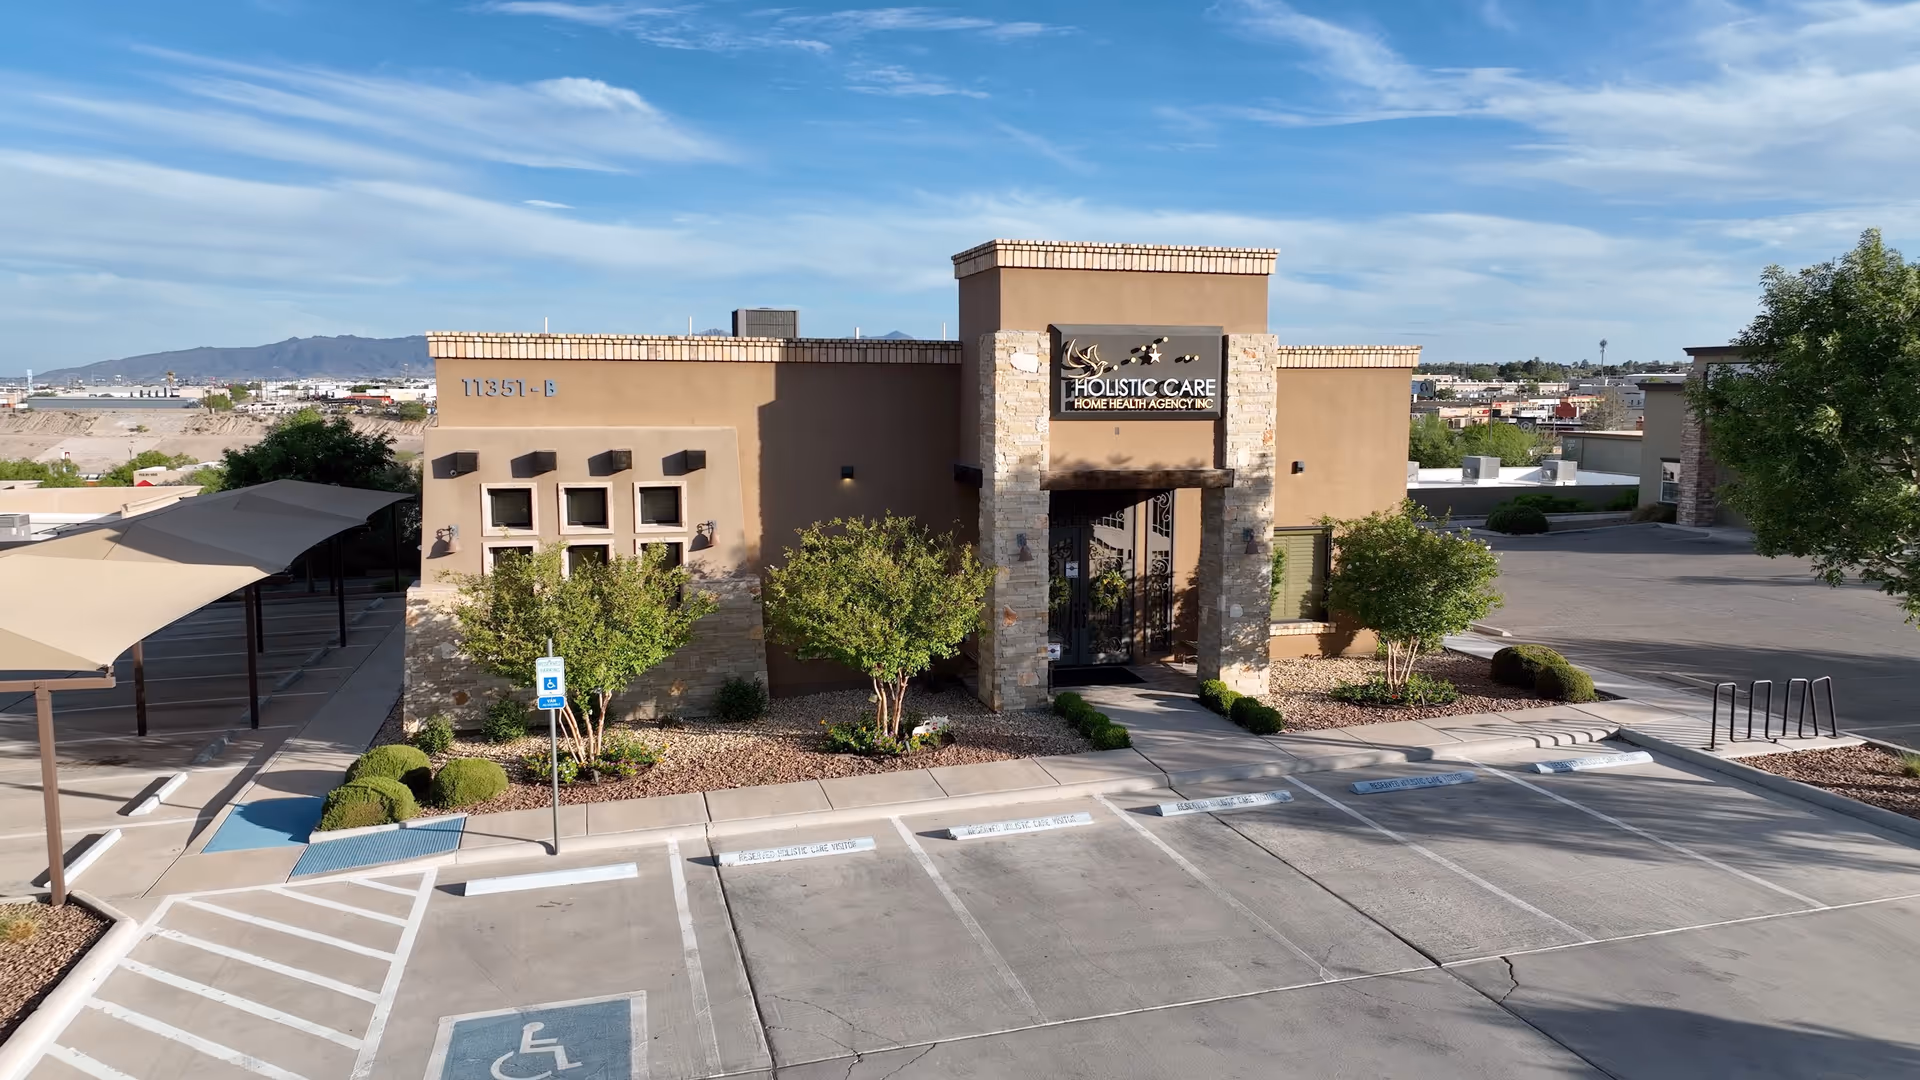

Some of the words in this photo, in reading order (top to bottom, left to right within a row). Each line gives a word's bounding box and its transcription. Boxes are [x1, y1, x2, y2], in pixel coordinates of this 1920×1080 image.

[461, 378, 558, 398] 11351-B
[1075, 378, 1158, 397] HOLISTIC
[1163, 378, 1216, 397] CARE
[1074, 398, 1108, 409] HOME
[1109, 398, 1147, 409] HEALTH
[1148, 398, 1194, 409] AGENCY
[1195, 398, 1214, 409] INC
[738, 850, 776, 862] RESERVED
[831, 840, 857, 851] VISITOR
